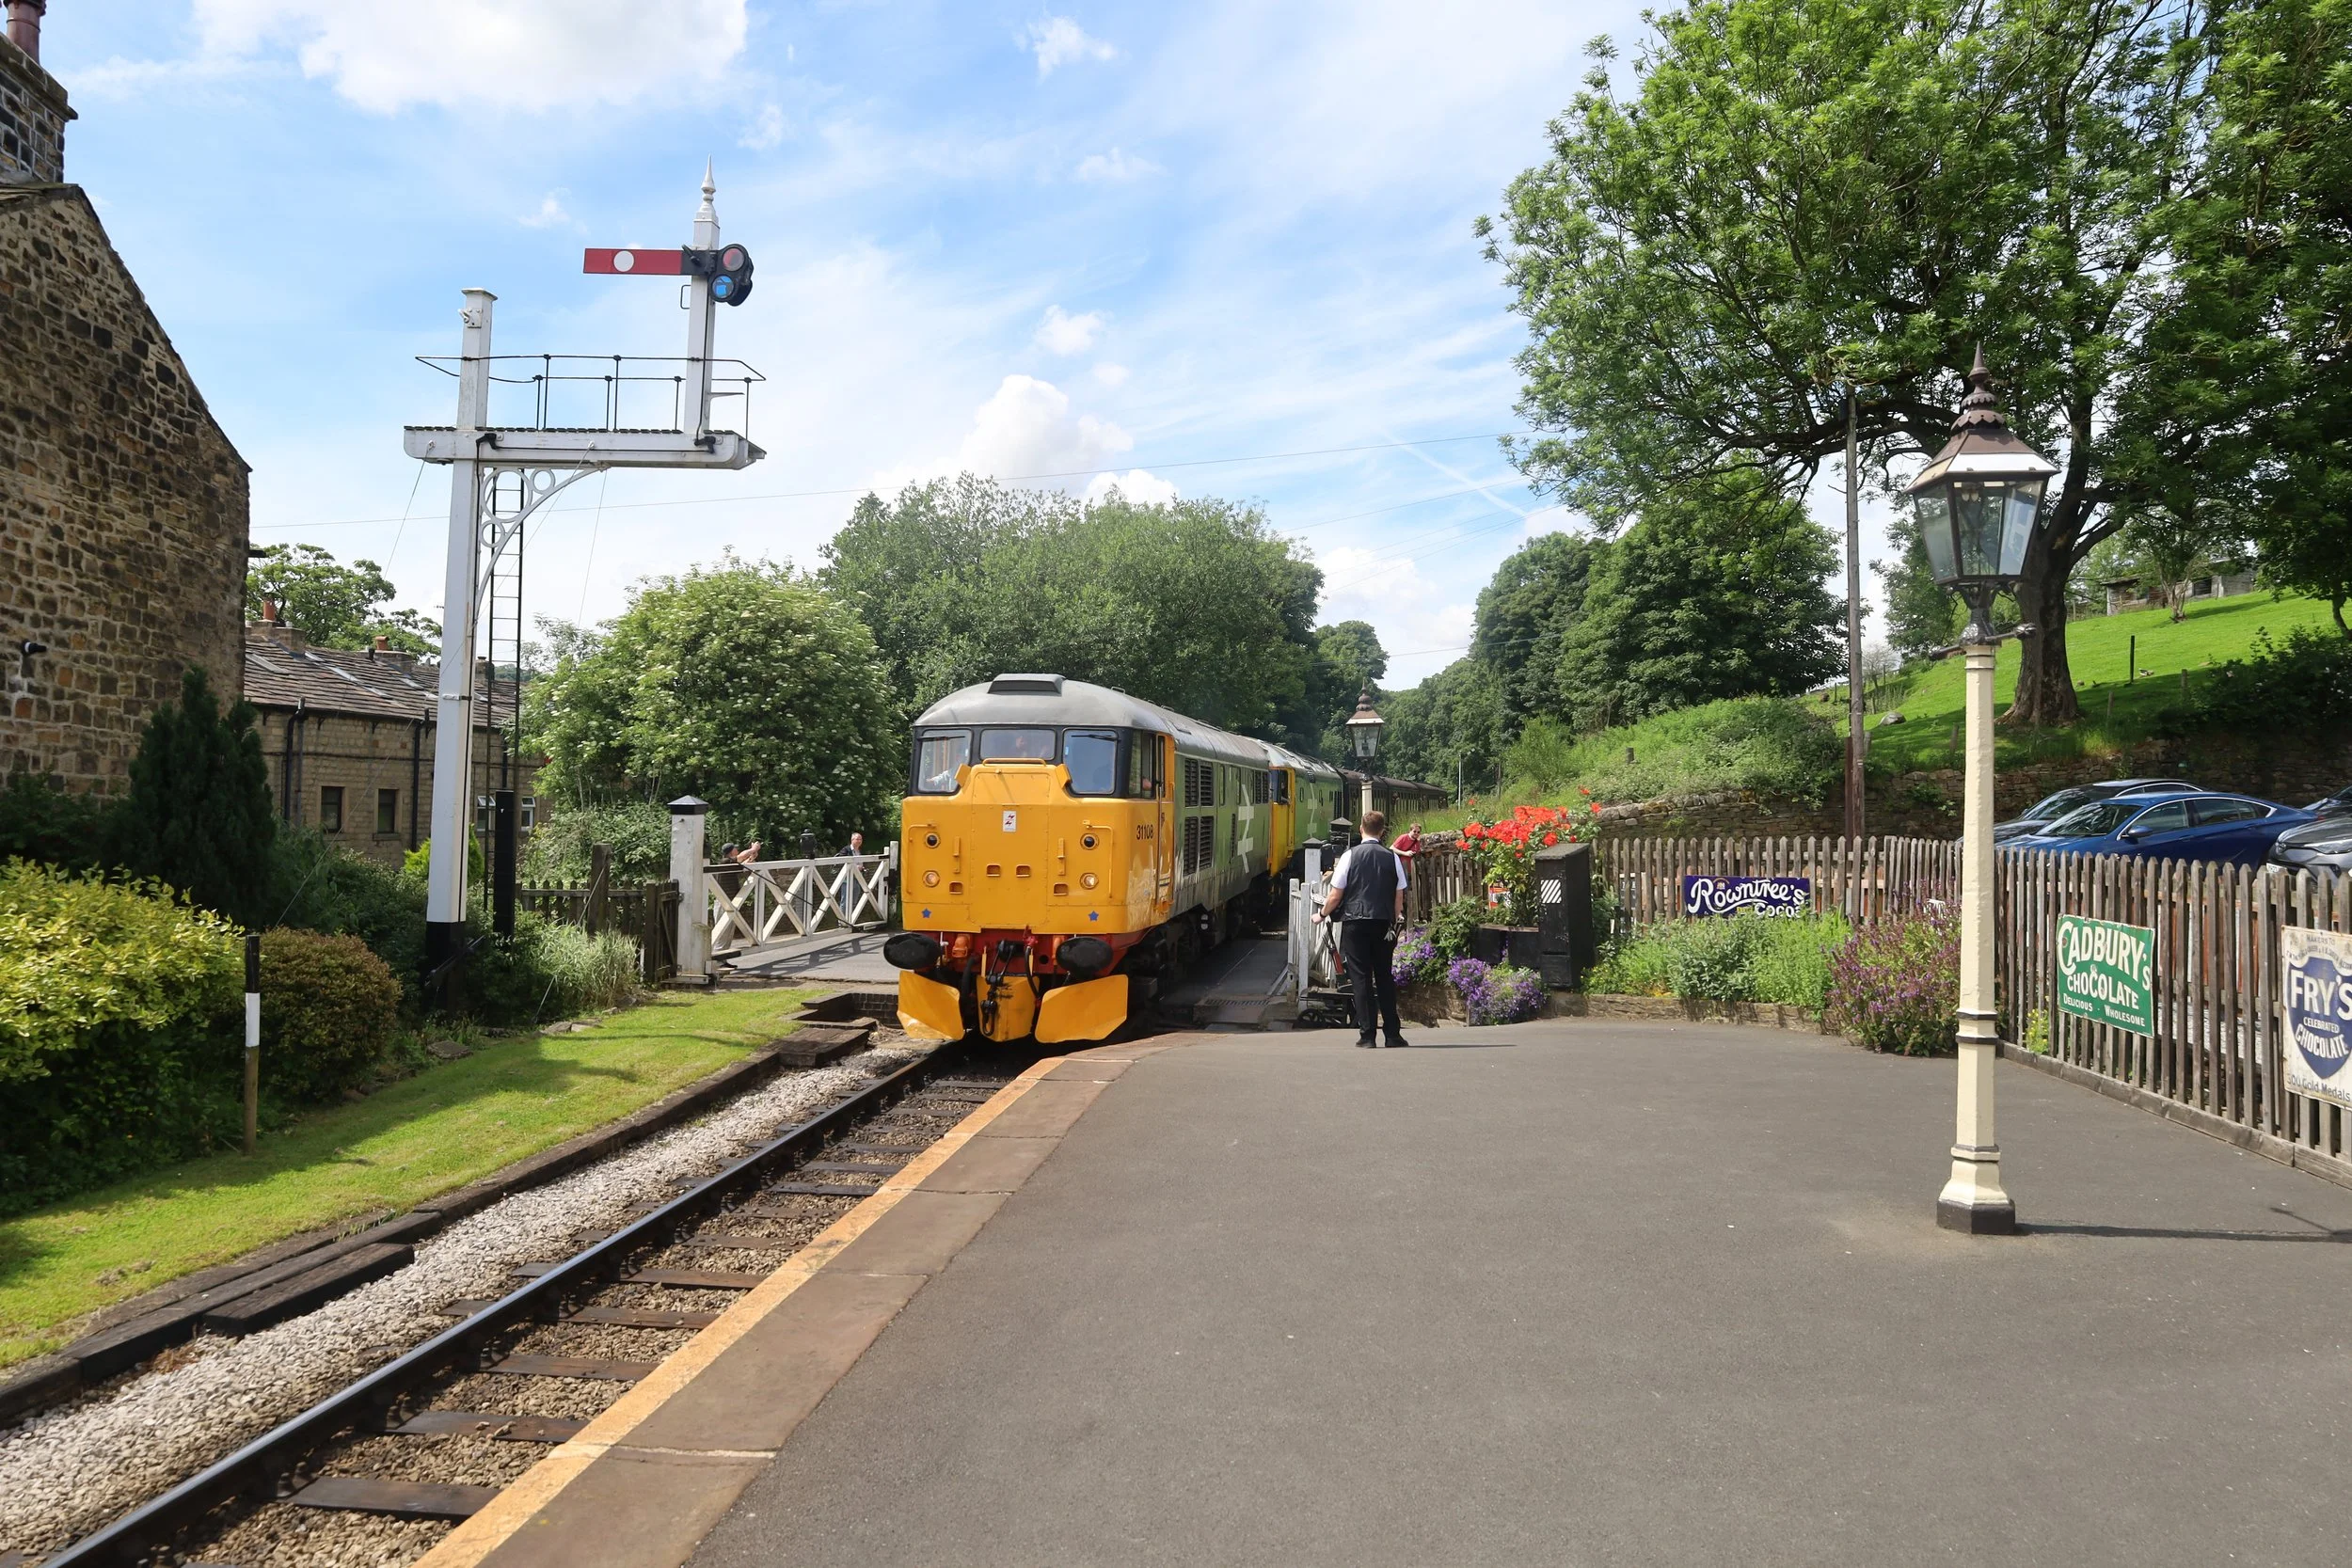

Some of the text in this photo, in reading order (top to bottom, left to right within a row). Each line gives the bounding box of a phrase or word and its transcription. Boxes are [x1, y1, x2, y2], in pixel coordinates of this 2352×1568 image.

[1136, 824, 1154, 840] 31108
[1688, 878, 1806, 914] Rowntree's
[2306, 934, 2336, 945] MAKERS TO
[2058, 921, 2151, 991] CADBURY'S
[2067, 972, 2139, 1010] CHOCOLATE
[2290, 969, 2352, 1021] FRY'S
[2105, 1005, 2146, 1027] WHOLESOME
[2303, 1017, 2340, 1034] CELEBRATED
[2295, 1023, 2350, 1059] CHOCOLATE
[2301, 1077, 2319, 1092] Gold
[2321, 1083, 2351, 1102] Medals
